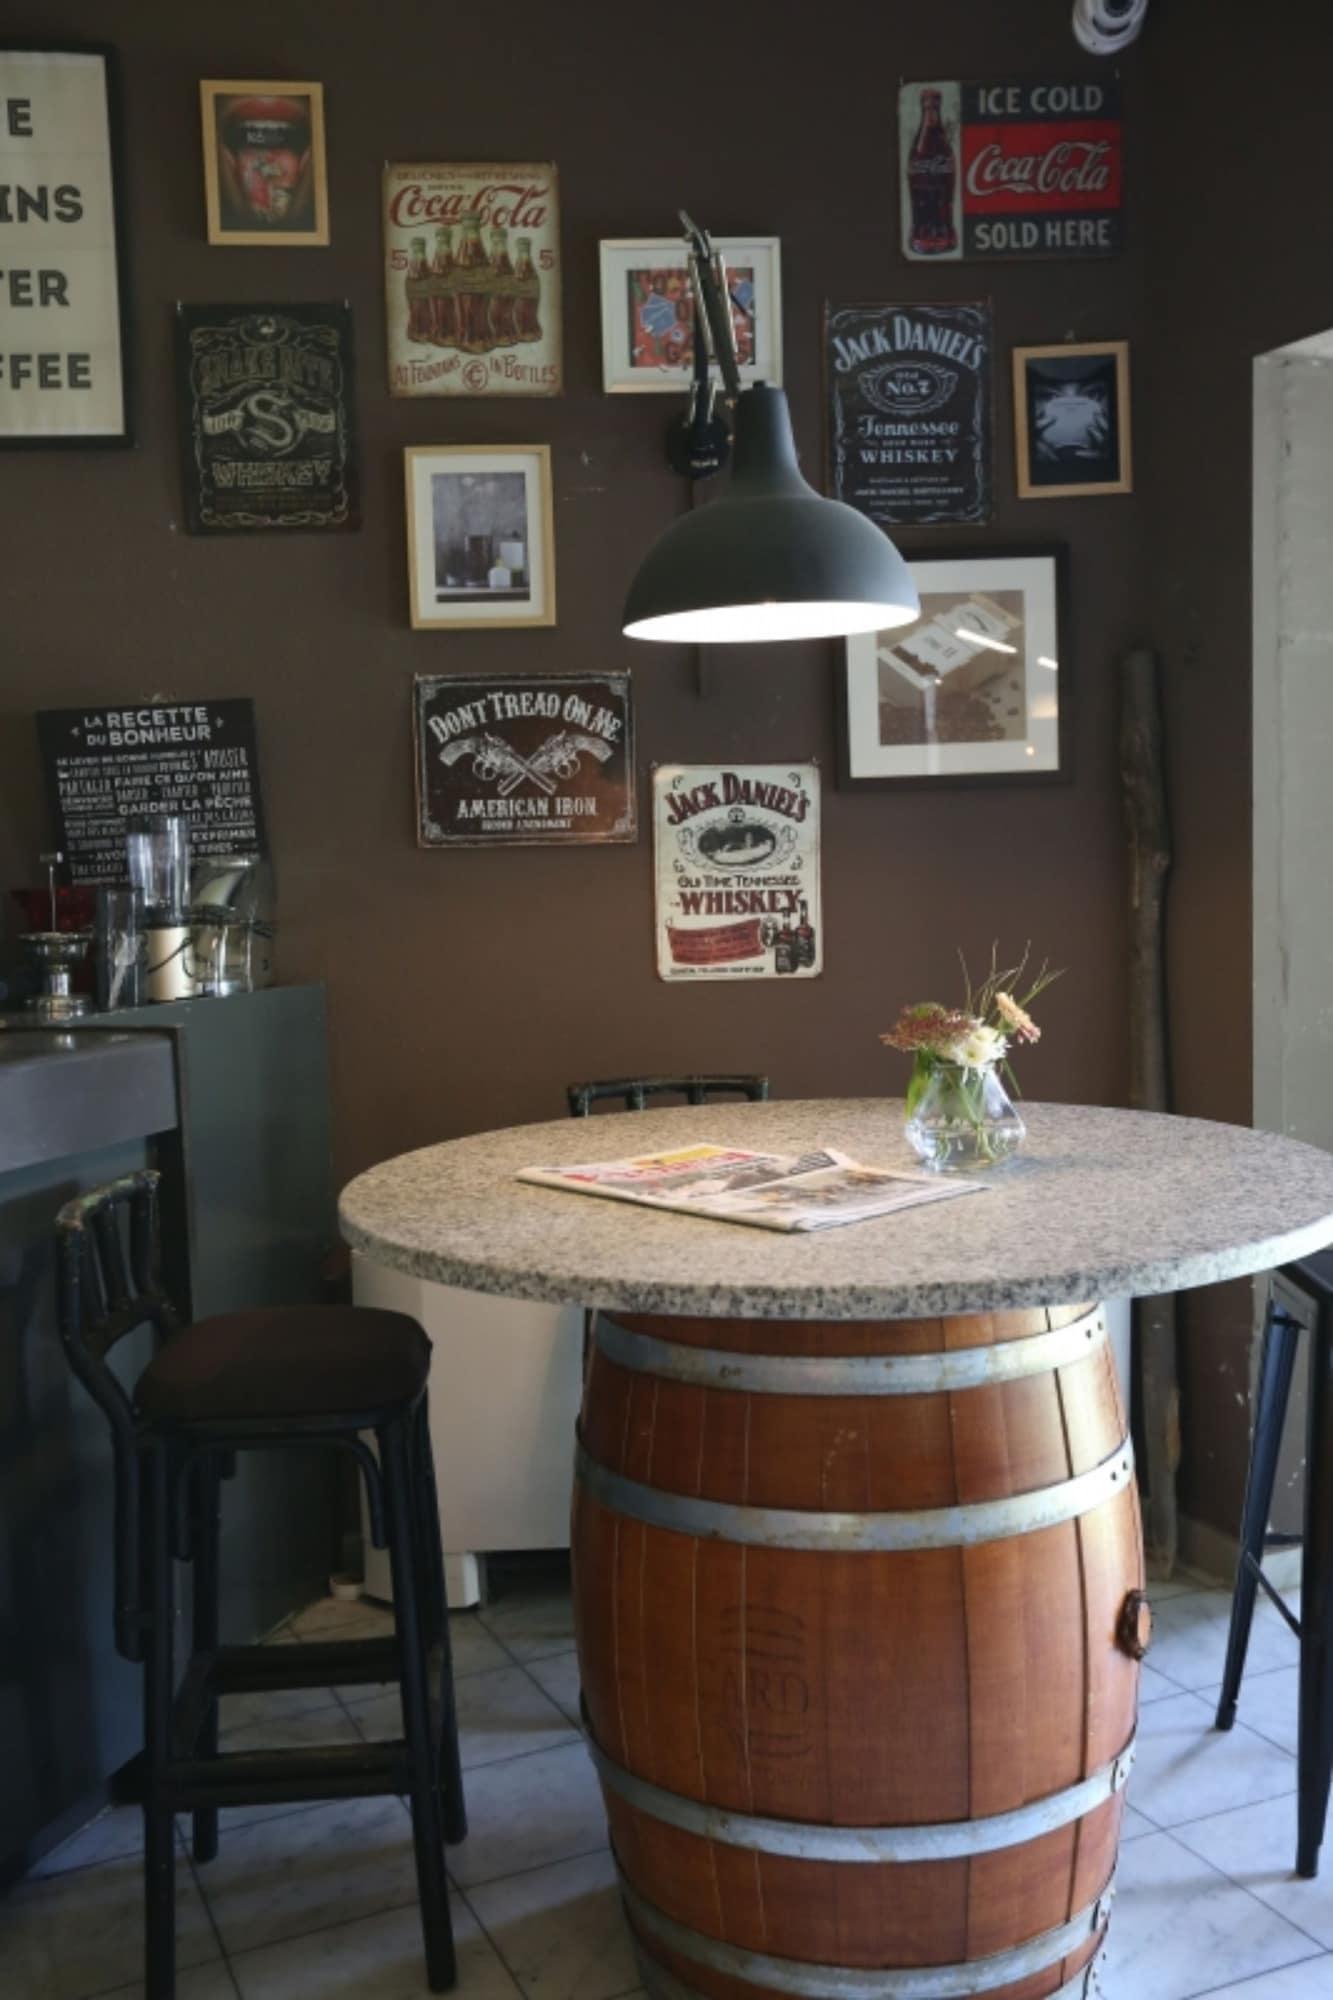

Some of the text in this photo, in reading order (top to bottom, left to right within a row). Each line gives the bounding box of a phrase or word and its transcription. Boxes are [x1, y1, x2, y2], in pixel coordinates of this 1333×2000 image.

[979, 85, 1103, 115] ICE COLD
[967, 140, 1112, 195] Coca-Cola
[974, 219, 1111, 249] SOLD HERE
[0, 270, 70, 307] ER
[832, 315, 988, 372] JACK DANIEL'S
[0, 354, 93, 390] FEE
[858, 415, 959, 438] Tennessee
[859, 449, 959, 464] WHISKEY
[84, 706, 210, 729] LA RECETTE
[487, 691, 562, 721] TREAD
[563, 694, 594, 731] ON
[590, 707, 623, 742] ME
[87, 724, 213, 746] DU BONHEUR
[119, 800, 179, 816] GARDER
[182, 799, 201, 811] LA
[456, 796, 598, 819] AMERICAN IRON
[664, 772, 812, 826] JACK DANIEL'S
[677, 889, 804, 916] WHISKEY
